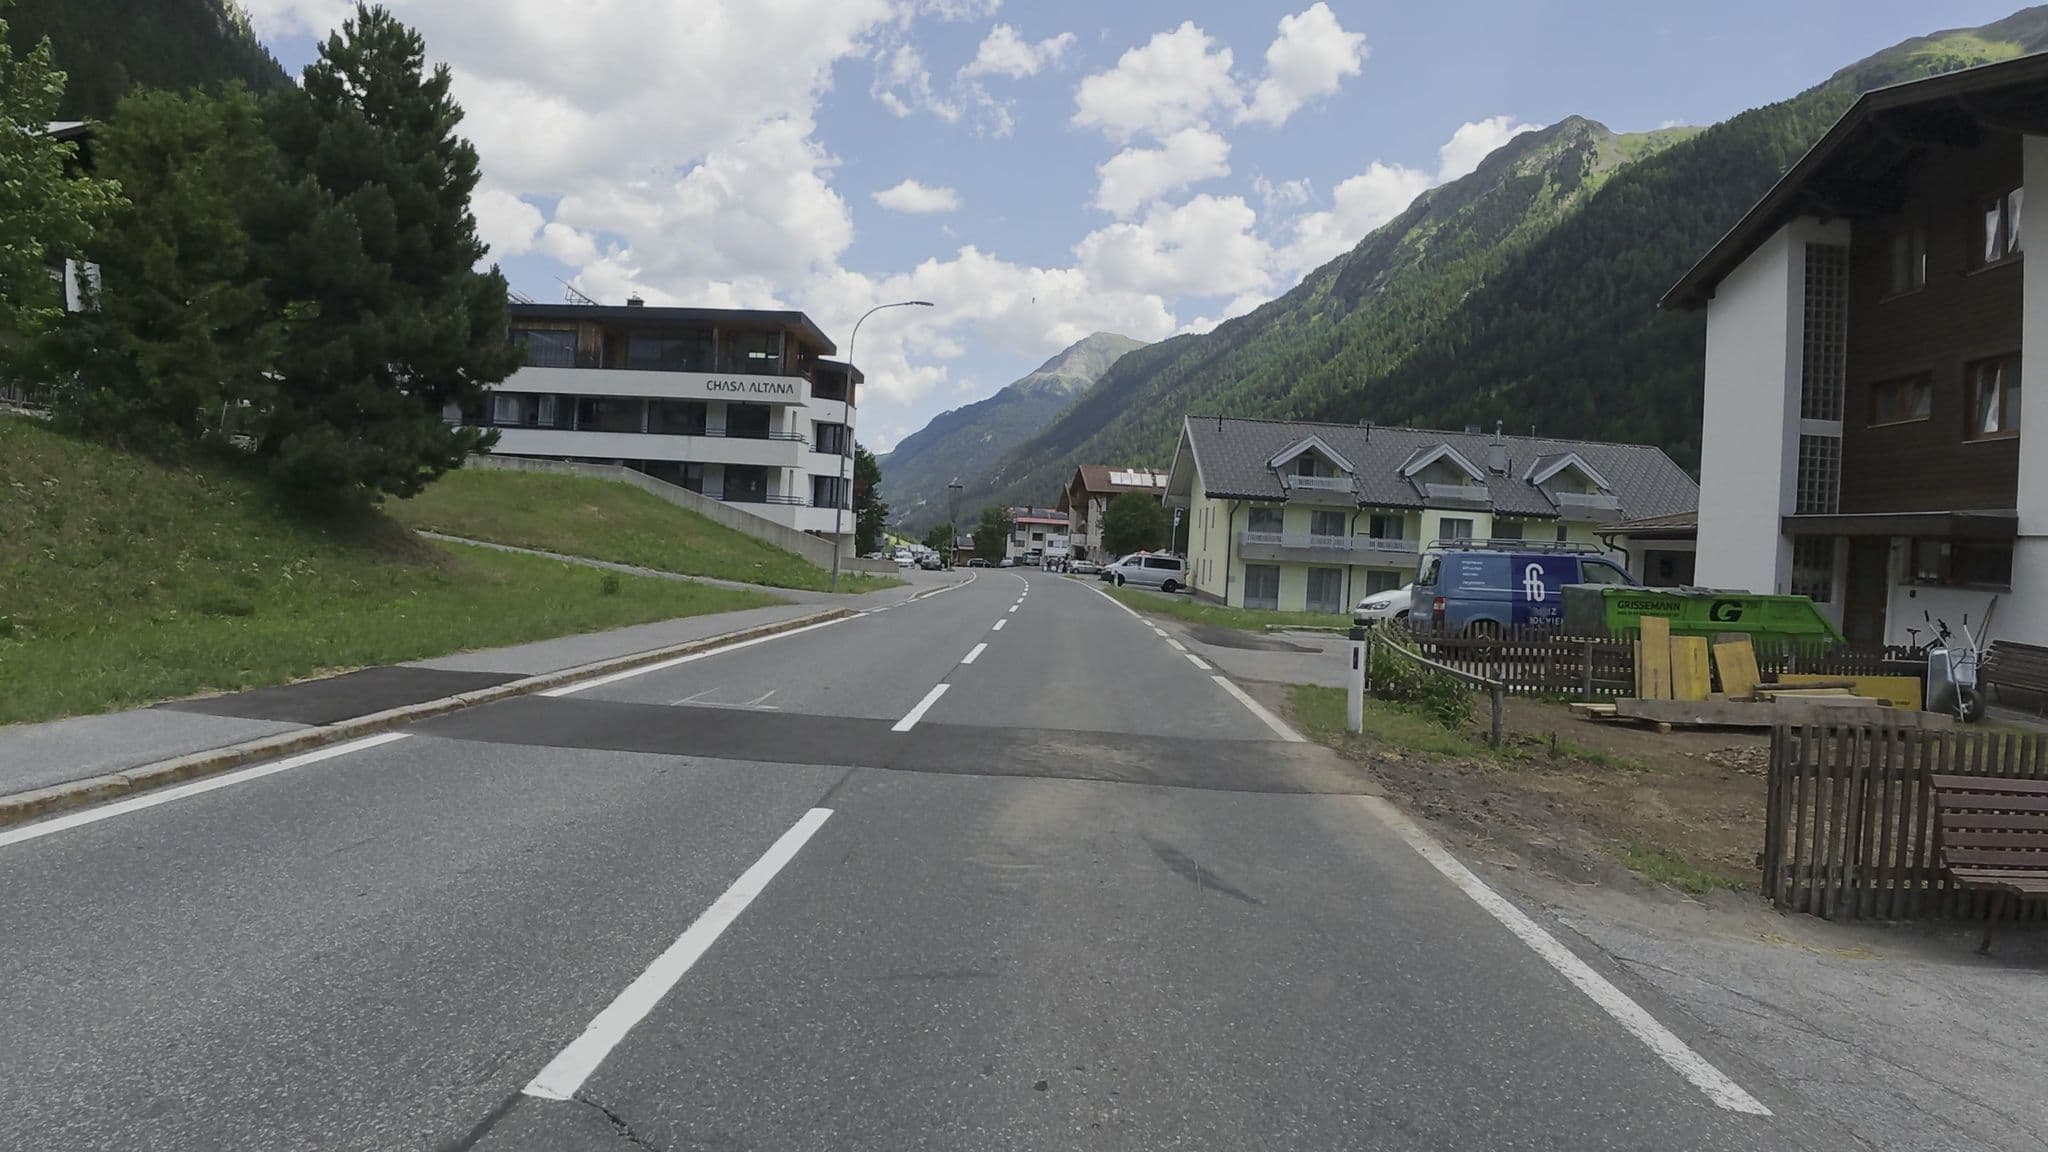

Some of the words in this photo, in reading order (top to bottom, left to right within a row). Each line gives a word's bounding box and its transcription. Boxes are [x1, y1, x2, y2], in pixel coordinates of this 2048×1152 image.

[706, 380, 745, 392] CHASA
[749, 382, 794, 394] ALTANA
[1617, 600, 1681, 611] GRISSEMANN
[1709, 600, 1743, 622] G
